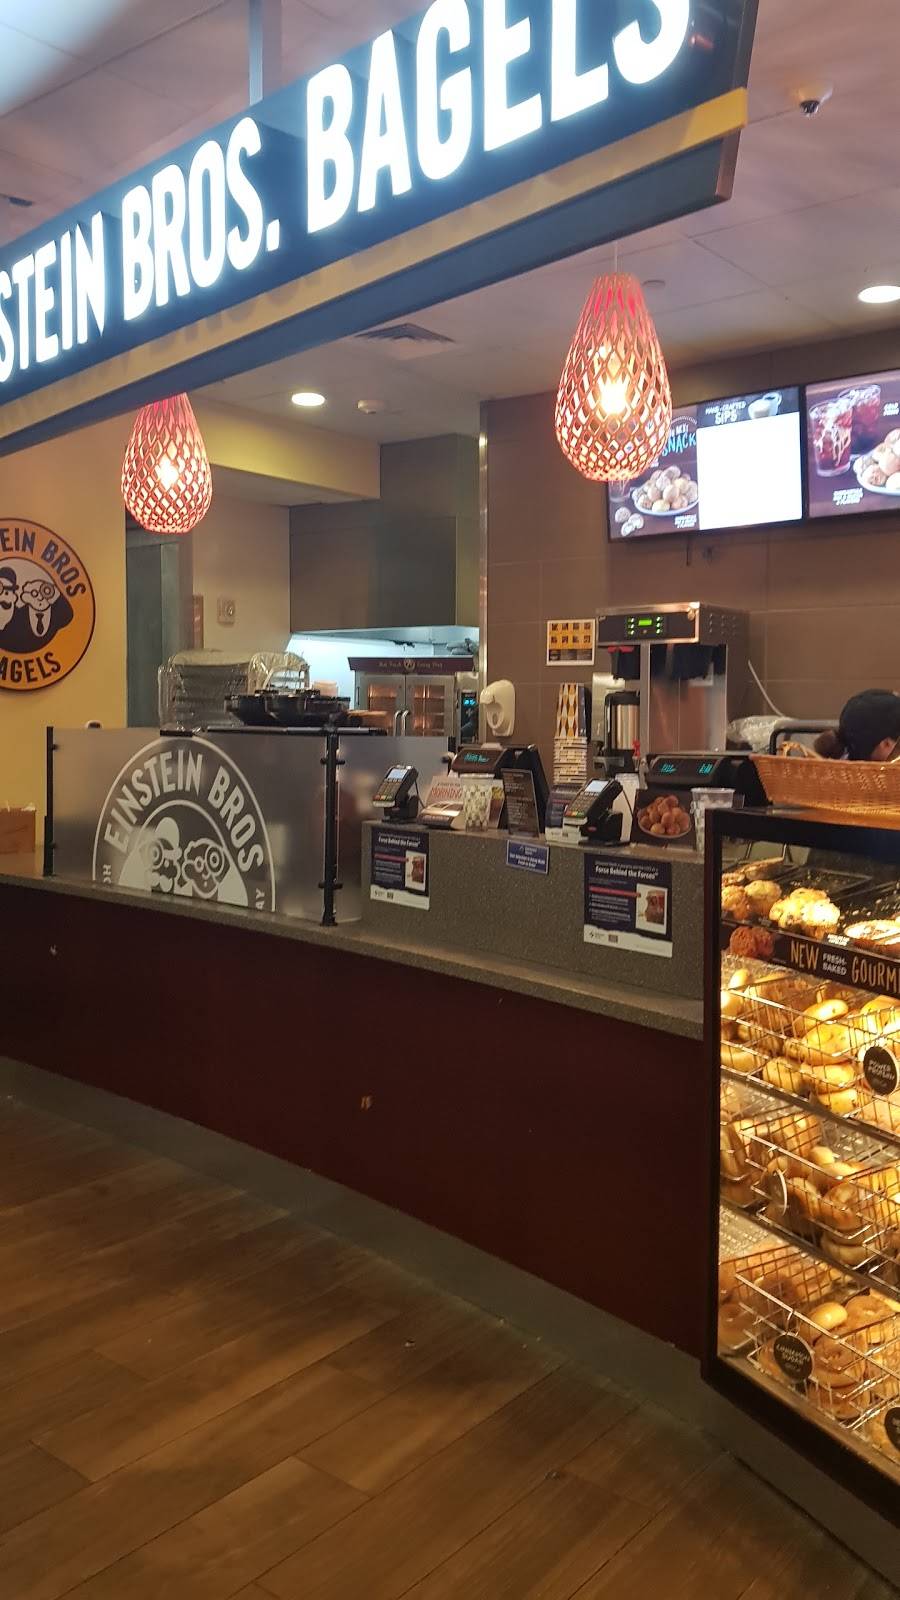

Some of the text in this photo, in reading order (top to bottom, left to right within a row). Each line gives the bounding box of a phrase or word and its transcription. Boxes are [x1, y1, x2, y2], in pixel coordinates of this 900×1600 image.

[122, 116, 280, 322] BROS.
[41, 539, 87, 598] BROS
[104, 748, 264, 873] EINSTEIN BROS
[790, 939, 900, 995] NEW GOURM
[822, 961, 848, 976] BAKED
